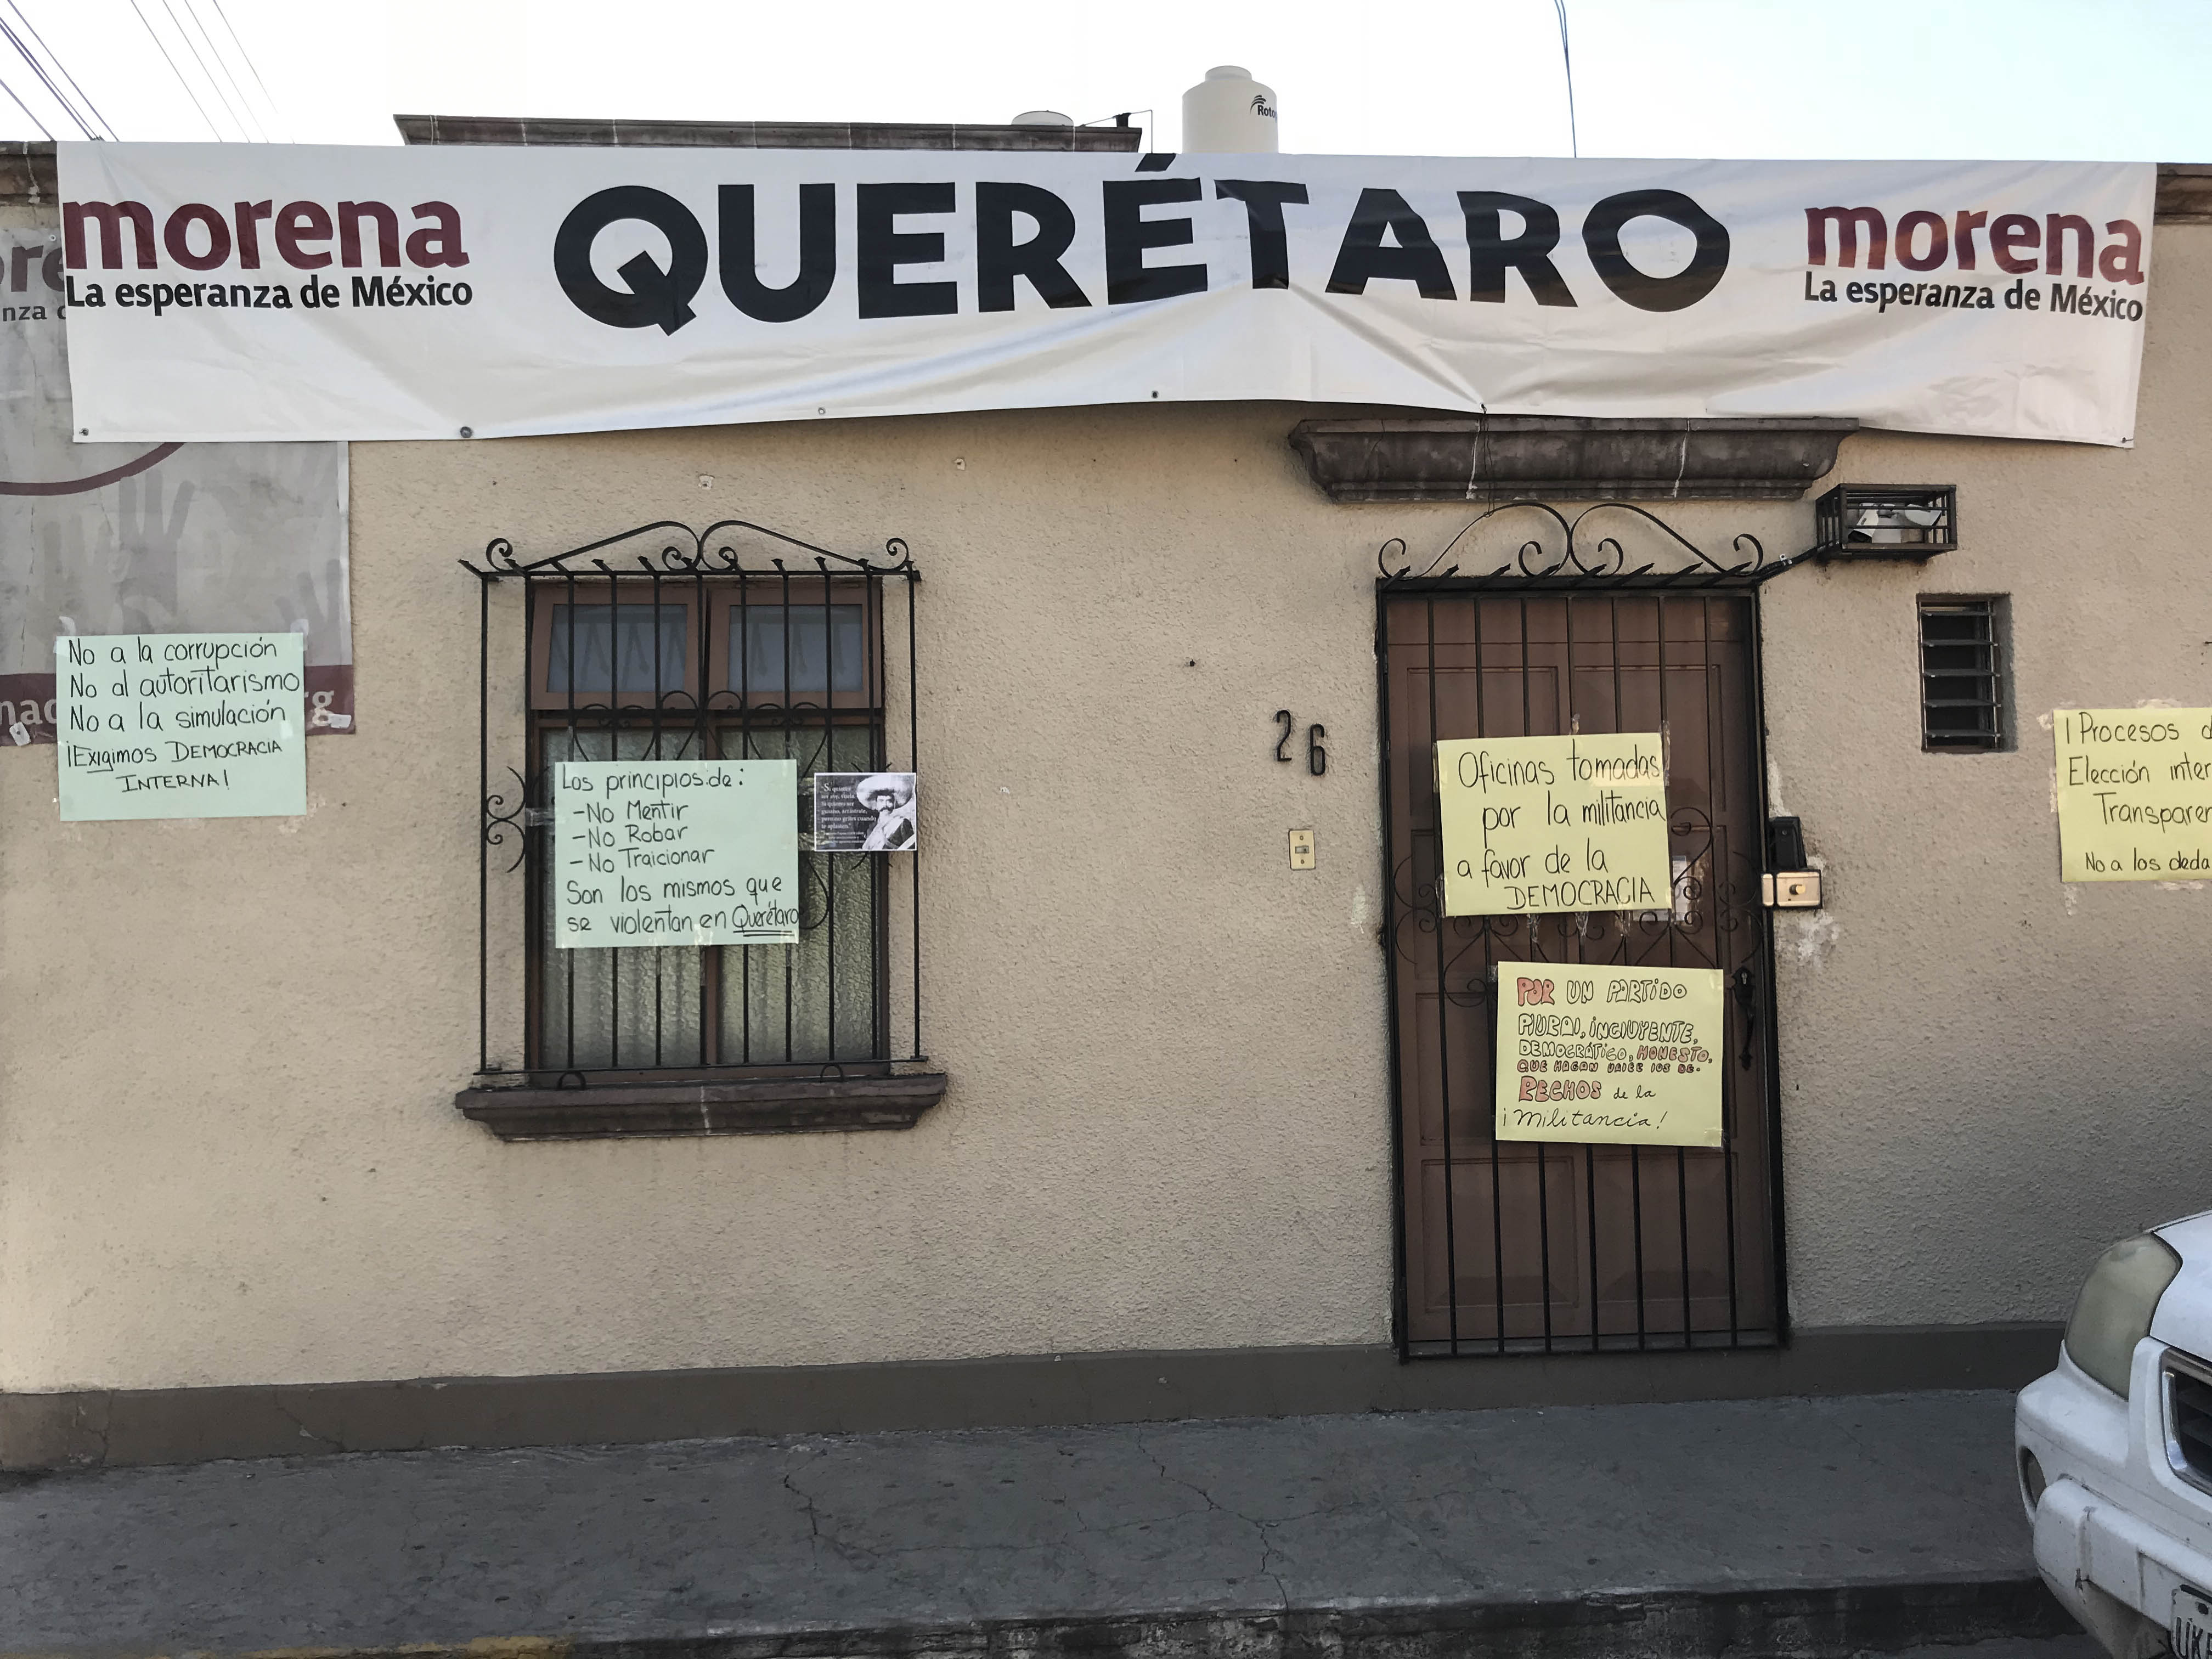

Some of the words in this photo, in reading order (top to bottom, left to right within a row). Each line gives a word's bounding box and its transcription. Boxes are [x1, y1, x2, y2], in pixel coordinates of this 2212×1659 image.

[63, 199, 470, 270] morena
[554, 153, 1730, 336] QUERÉTARO
[1804, 206, 2145, 285] morena
[66, 276, 105, 307] La
[116, 281, 290, 316] esperanza
[301, 274, 340, 309] de
[352, 275, 473, 308] México
[1805, 272, 1837, 302] La
[1846, 279, 1994, 313] esperanza
[2005, 279, 2040, 311] de
[2050, 283, 2143, 321] México
[69, 638, 94, 666] No
[111, 647, 126, 663] a
[138, 636, 153, 663] la
[165, 637, 276, 669] corrupción
[71, 673, 97, 698] No
[112, 670, 128, 697] al
[139, 665, 300, 697] autoritarismo
[71, 705, 99, 732] No
[110, 714, 125, 732] a
[140, 702, 163, 731] la
[176, 699, 285, 728] simulación
[1276, 710, 1325, 776] 26
[562, 764, 593, 791] Los
[1459, 751, 1555, 794] Oficinas
[1566, 738, 1660, 781] tomadas
[2069, 755, 2150, 786] Elección
[627, 800, 689, 821] Mentir
[1483, 806, 1521, 849] por
[1548, 790, 1571, 827] la
[1583, 789, 1666, 826] militancia
[625, 823, 687, 843] Robar
[618, 847, 714, 868] Traicionar
[1458, 860, 1472, 879] a
[1482, 849, 1531, 888] favor
[1545, 844, 1571, 874] de
[1587, 838, 1609, 873] la
[2085, 851, 2106, 872] No
[2111, 860, 2123, 871] a
[2134, 847, 2161, 871] los
[567, 881, 602, 905] Son
[621, 876, 651, 902] los
[664, 880, 735, 898] mismos
[747, 877, 782, 905] que
[1504, 877, 1655, 910] DEMOCRACIA
[568, 914, 591, 932] se
[610, 905, 692, 934] violentan
[700, 911, 726, 929] en
[732, 900, 799, 933] Querétaro
[1517, 977, 1555, 1007] POR
[1567, 980, 1594, 1004] UN
[1517, 1059, 1547, 1073] QUE
[1554, 1060, 1599, 1072] HAGAN
[1613, 1087, 1628, 1099] de
[1636, 1085, 1656, 1099] la
